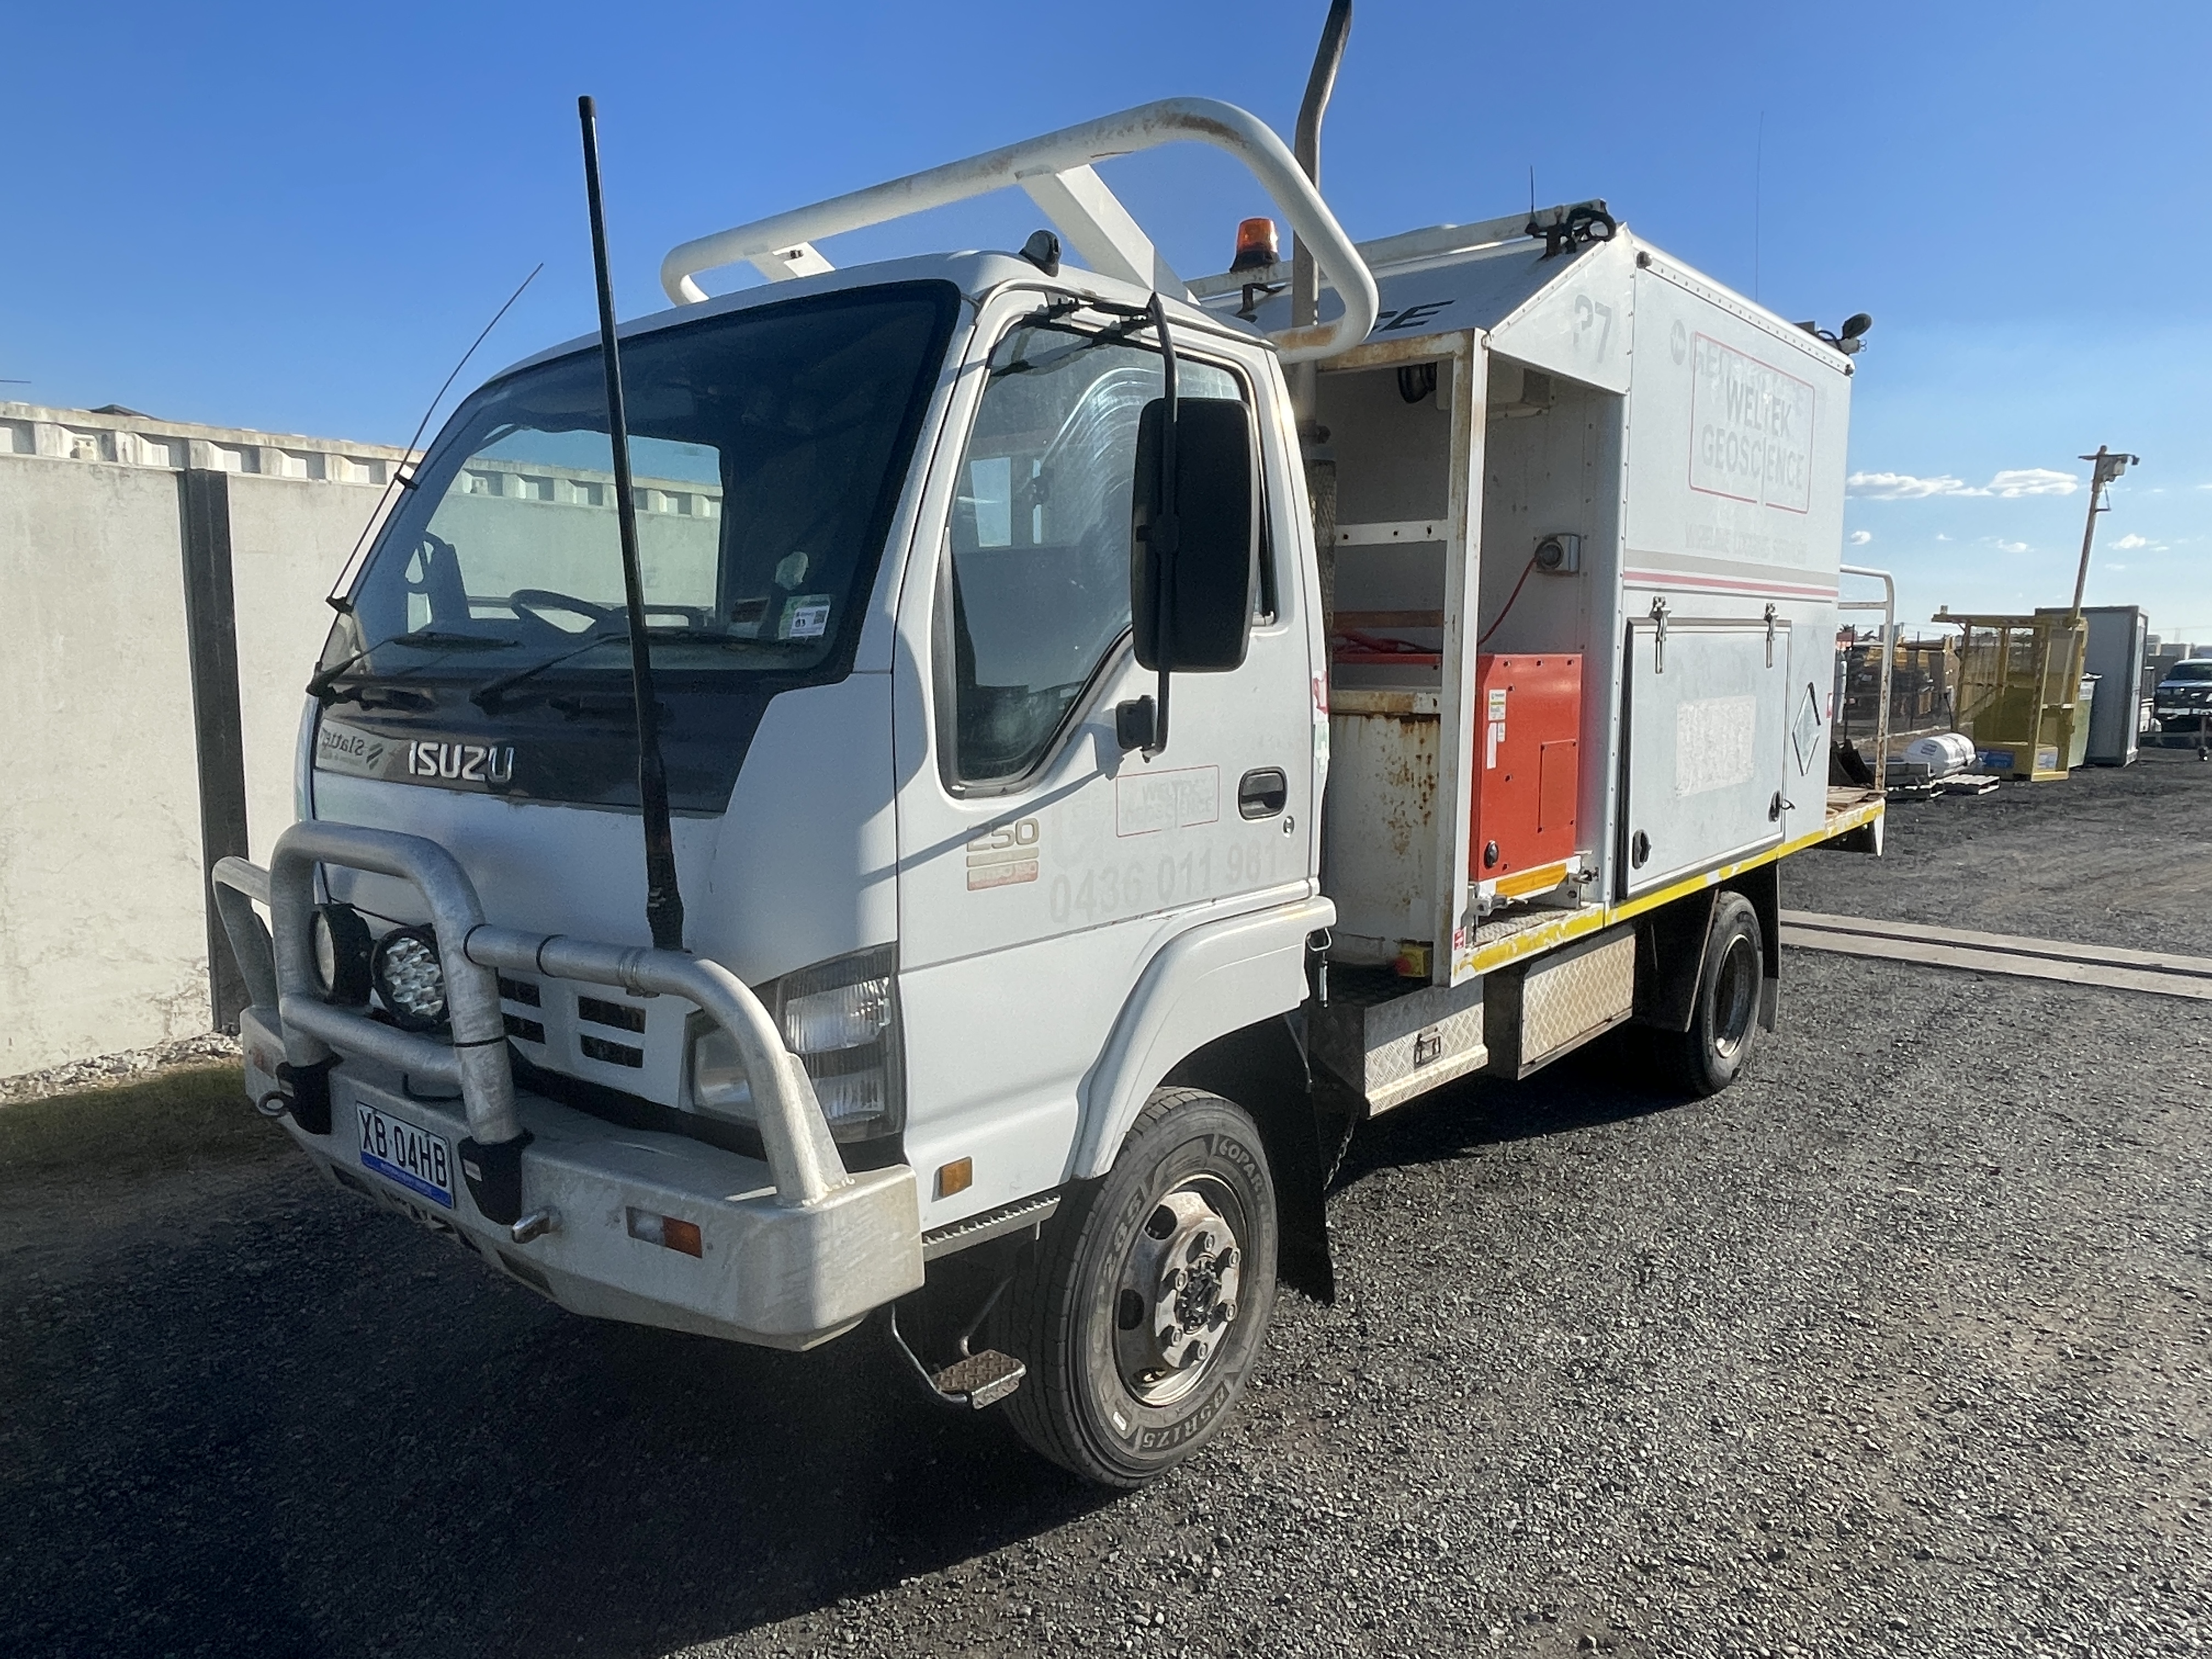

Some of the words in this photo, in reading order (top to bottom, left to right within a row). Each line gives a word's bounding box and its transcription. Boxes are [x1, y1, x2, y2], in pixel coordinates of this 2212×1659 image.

[1702, 424, 1805, 490] GEOSCIENCE
[409, 740, 515, 784] ISUZU
[1157, 848, 1212, 905] 011
[359, 1109, 387, 1158] XB
[394, 1126, 447, 1187] 04HB
